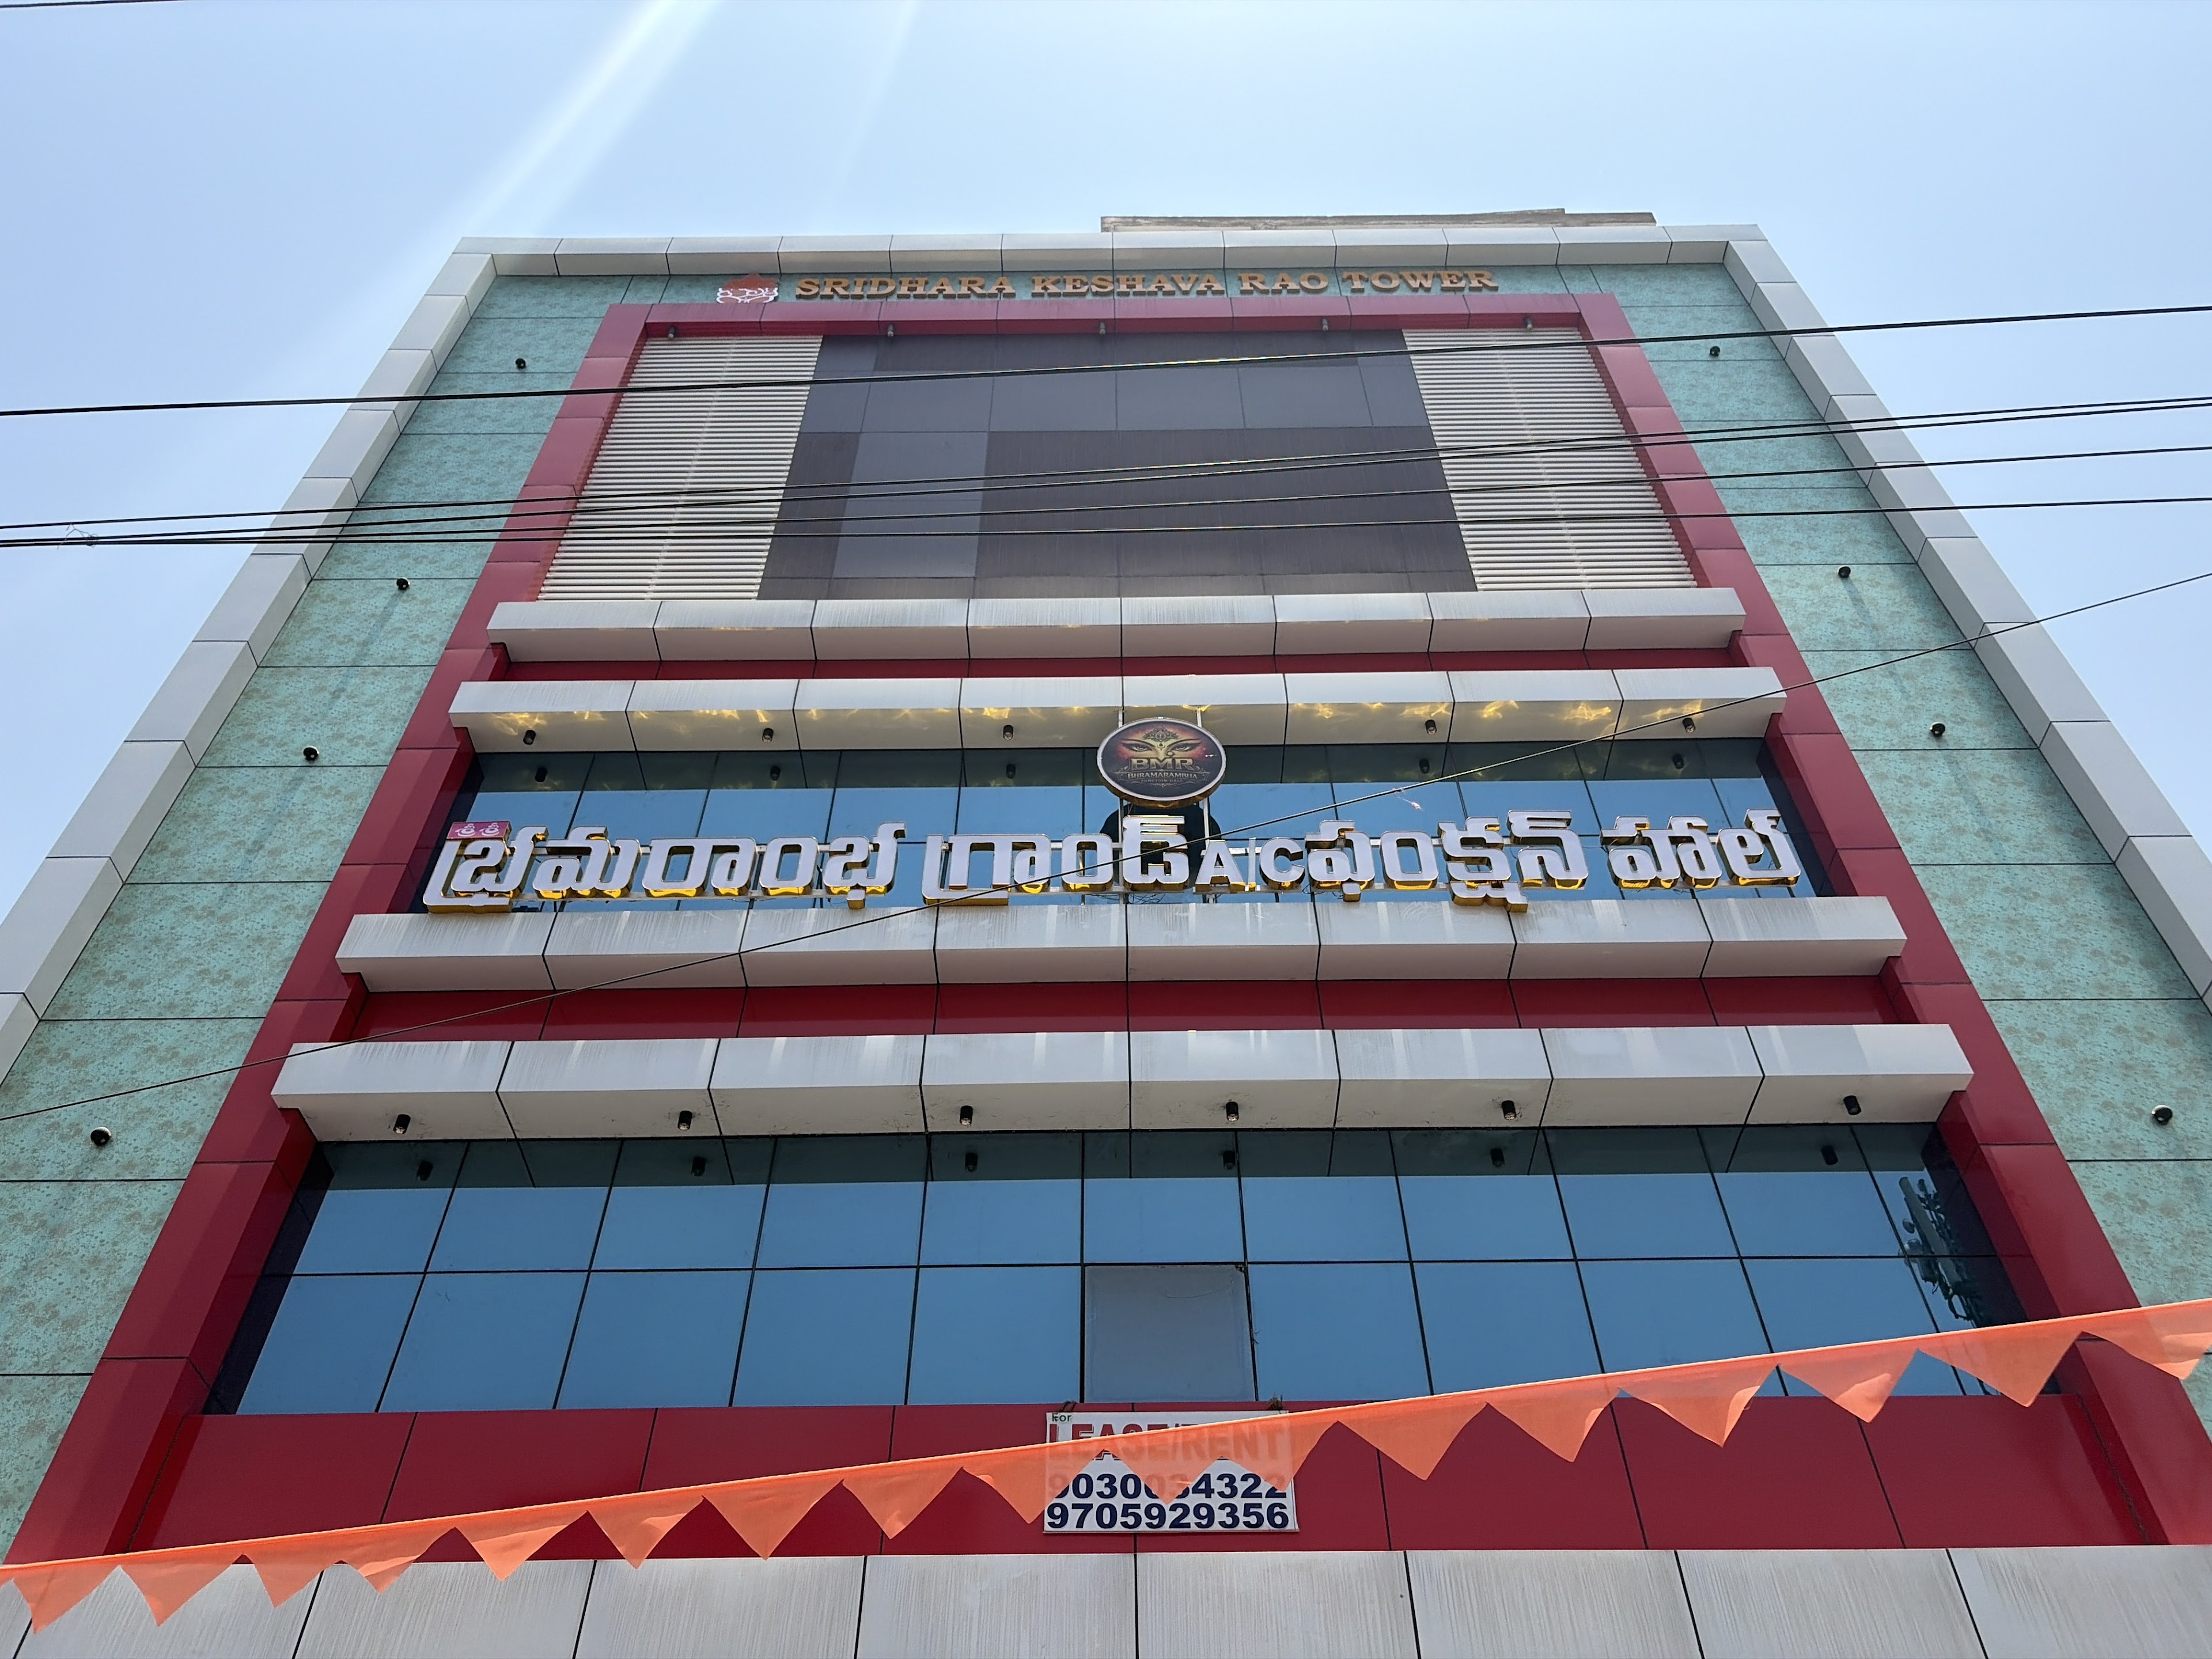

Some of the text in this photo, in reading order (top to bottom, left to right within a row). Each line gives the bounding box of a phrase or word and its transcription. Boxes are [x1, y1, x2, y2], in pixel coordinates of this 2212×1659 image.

[795, 271, 1498, 299] SRIDHARA KESHAVA RAO TOWER
[1130, 758, 1196, 771] BMR
[1127, 771, 1198, 779] BHRAMARAMBHA
[922, 815, 1190, 903] గ్రాండ్
[1304, 810, 1589, 911] ఫంక్షన్
[1600, 808, 1801, 887] హాల్
[1052, 1413, 1072, 1422] For
[1047, 1502, 1289, 1529] 9705929356
